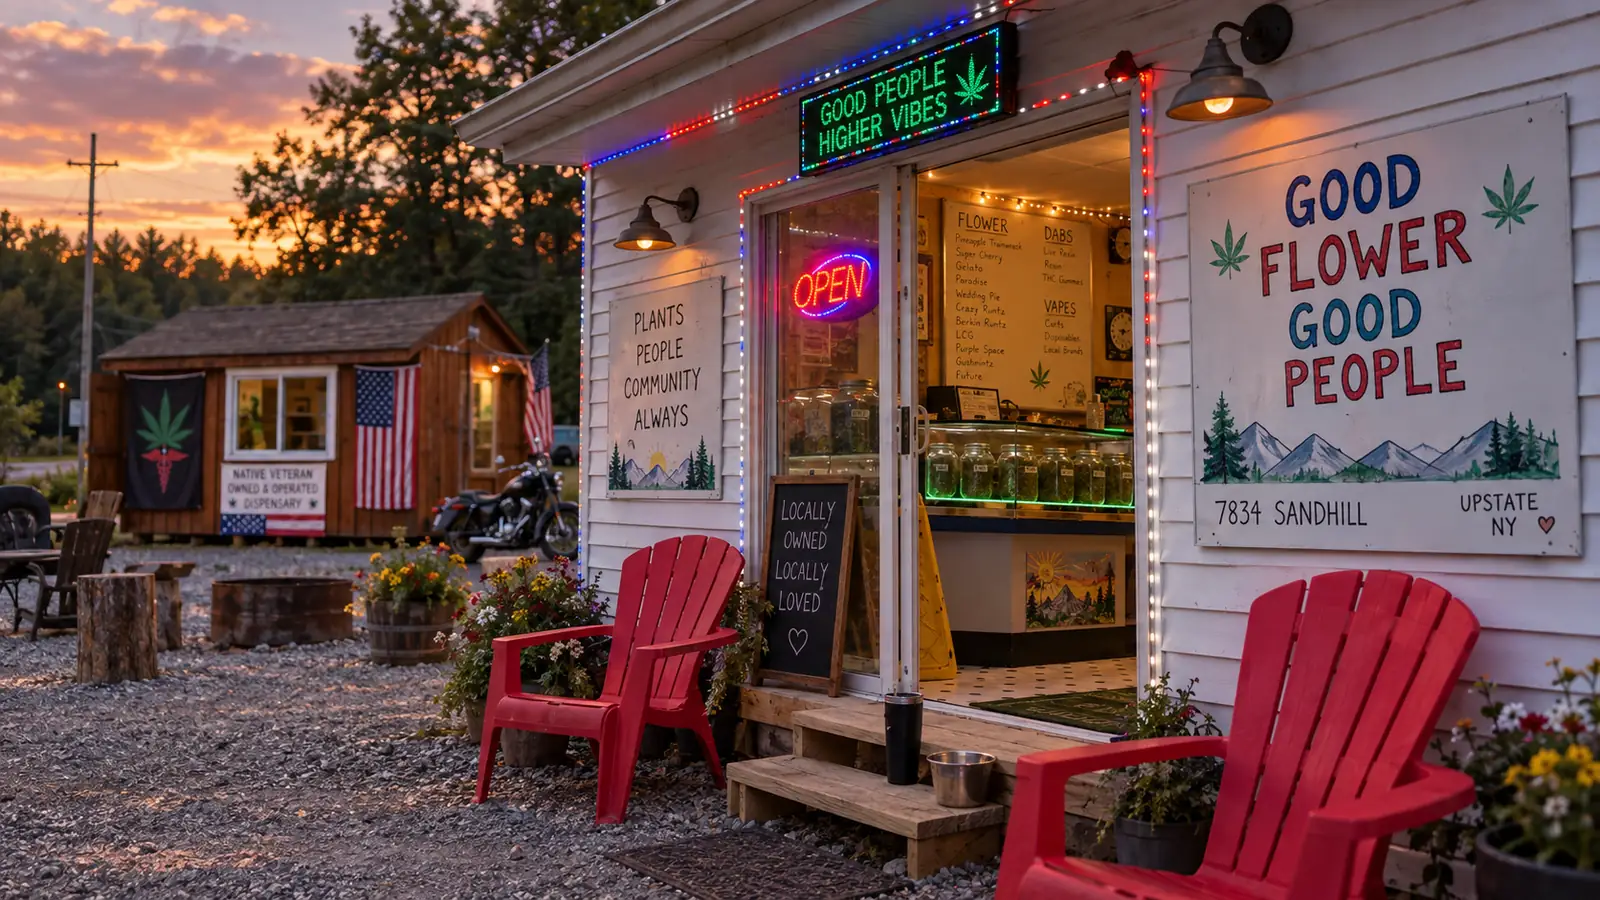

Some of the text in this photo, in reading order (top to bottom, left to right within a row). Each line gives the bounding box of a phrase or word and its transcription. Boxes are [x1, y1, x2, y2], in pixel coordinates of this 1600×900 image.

[820, 58, 946, 126] GOOD PEOPLE
[819, 91, 948, 157] HIGHER VIBES
[1285, 154, 1421, 229] GOOD
[958, 212, 1008, 233] FLOWER
[1045, 226, 1074, 243] DABS
[980, 250, 1002, 264] Cherry
[1260, 209, 1473, 297] FLOWER
[956, 261, 983, 272] Gelato
[793, 261, 866, 308] OPEN
[956, 274, 988, 286] Paradise
[956, 289, 1001, 304] Wedding Pie
[1044, 299, 1076, 315] VAPES
[634, 303, 684, 335] PLANTS
[956, 302, 1006, 316] Crazy Runtz
[1289, 288, 1422, 350] GOOD
[984, 317, 1007, 328] Runtz
[956, 330, 974, 340] LCG
[636, 337, 683, 366] PEOPLE
[956, 343, 1005, 357] Purple Space
[624, 367, 701, 399] COMMUNITY
[1285, 339, 1466, 407] PEOPLE
[634, 403, 689, 431] ALWAYS
[233, 468, 313, 480] NATIVE VETERAN
[228, 483, 319, 494] OWNED & OPERATED
[244, 498, 302, 510] DISPENSARY
[1460, 492, 1538, 512] UPSTATE
[781, 499, 837, 530] LOCALLY
[1215, 499, 1368, 527] 7834 SANDHILL
[1491, 517, 1516, 537] NY
[783, 530, 828, 551] OWNED
[775, 559, 829, 591] LOCALLY
[778, 590, 821, 613] LOVED
